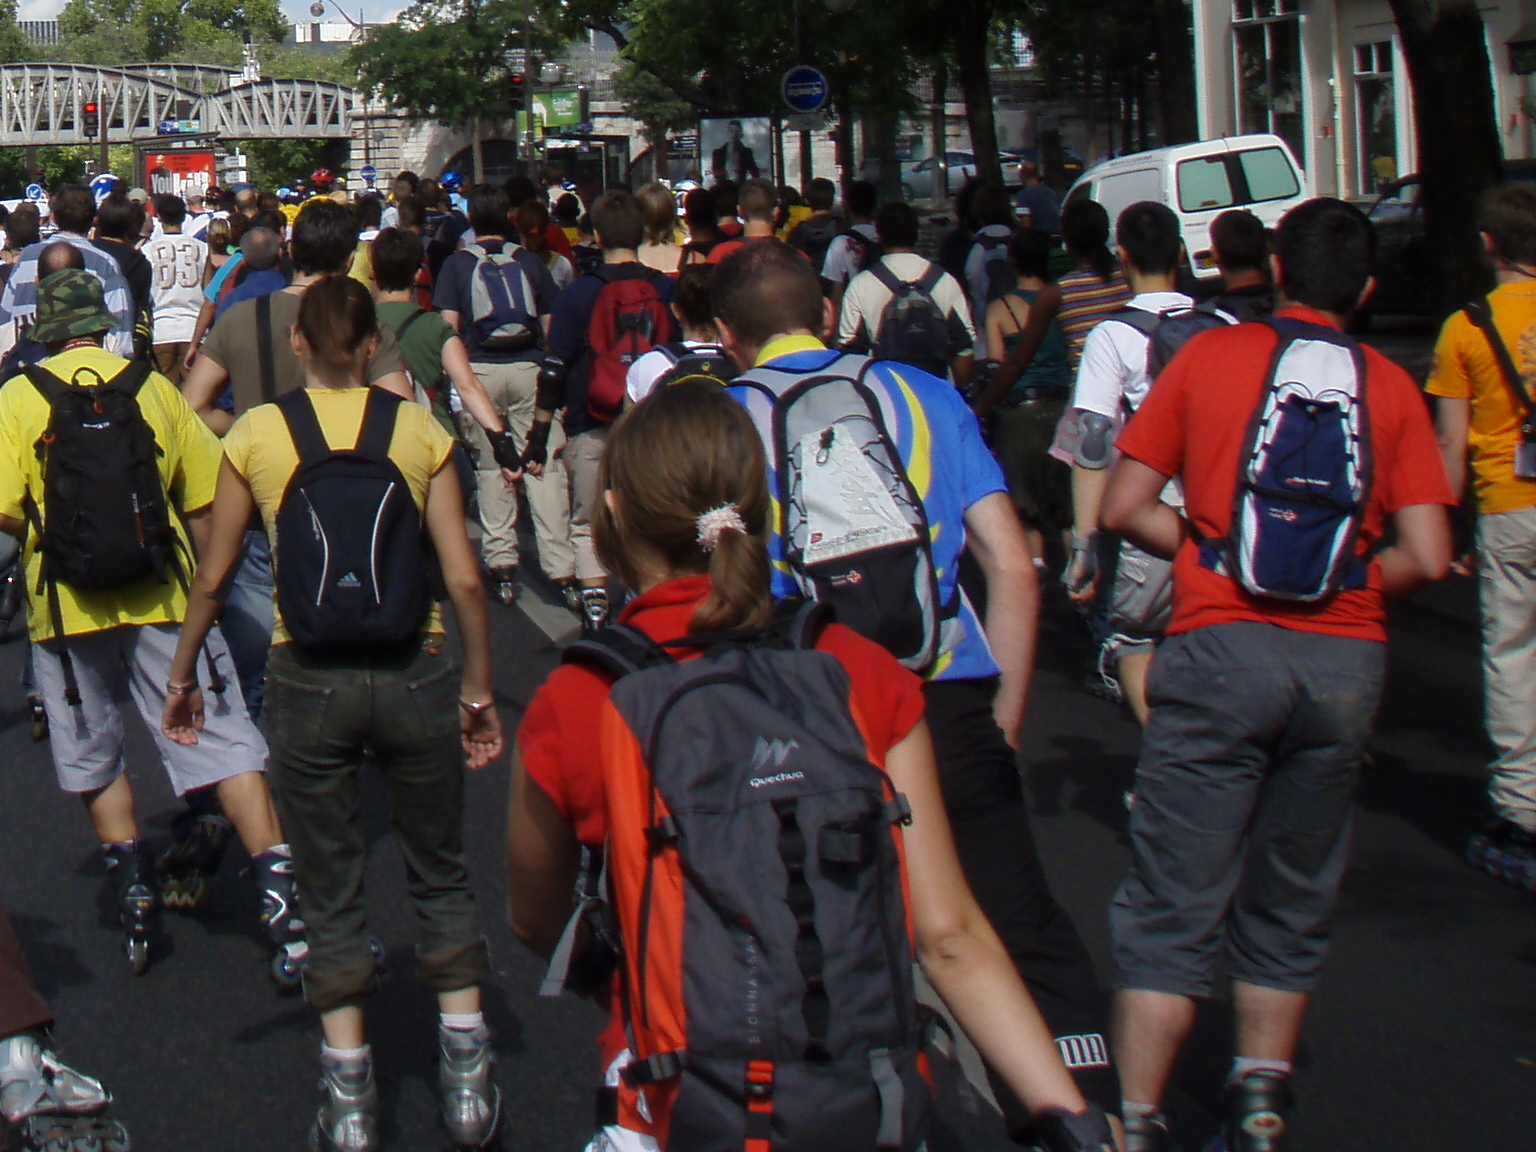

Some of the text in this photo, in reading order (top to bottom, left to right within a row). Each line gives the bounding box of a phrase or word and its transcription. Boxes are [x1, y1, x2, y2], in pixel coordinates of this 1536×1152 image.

[151, 237, 200, 290] 83
[748, 770, 805, 789] Quechua
[1055, 1033, 1108, 1067] MA
